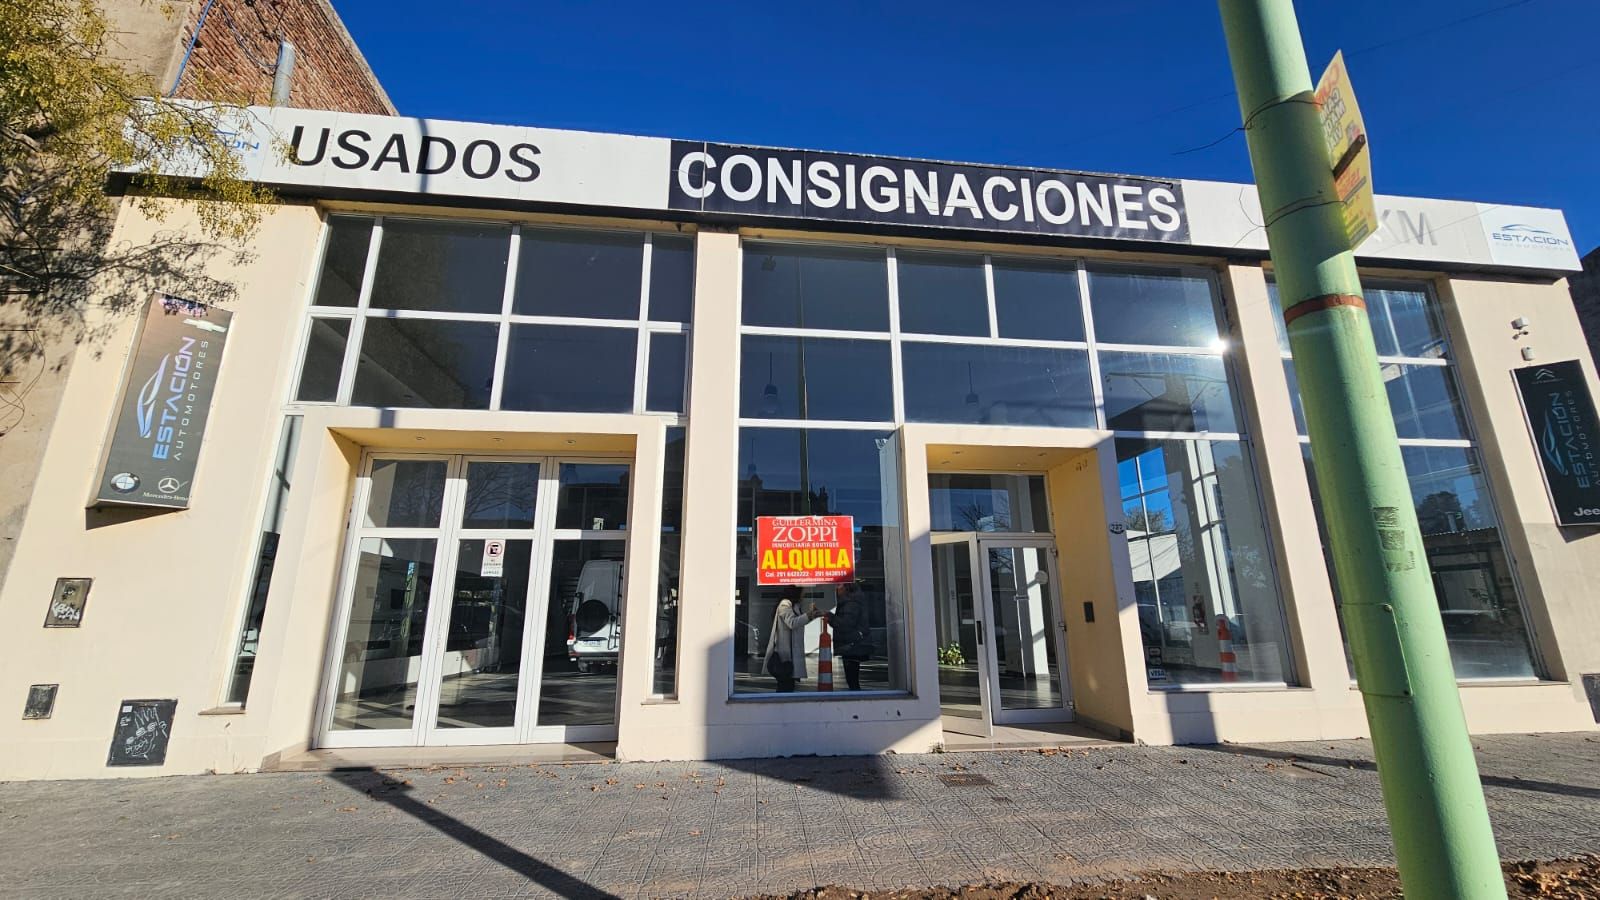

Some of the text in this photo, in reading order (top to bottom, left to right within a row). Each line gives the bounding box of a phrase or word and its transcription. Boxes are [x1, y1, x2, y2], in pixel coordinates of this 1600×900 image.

[289, 125, 542, 182] USADOS
[678, 151, 1181, 232] CONSIGNACIONES
[174, 340, 208, 461] AUTOMOTORES
[1574, 506, 1600, 516] Jee
[772, 519, 838, 527] GUILLERMINA
[772, 526, 838, 543] ZOPPI
[761, 548, 851, 571] ALQUILA
